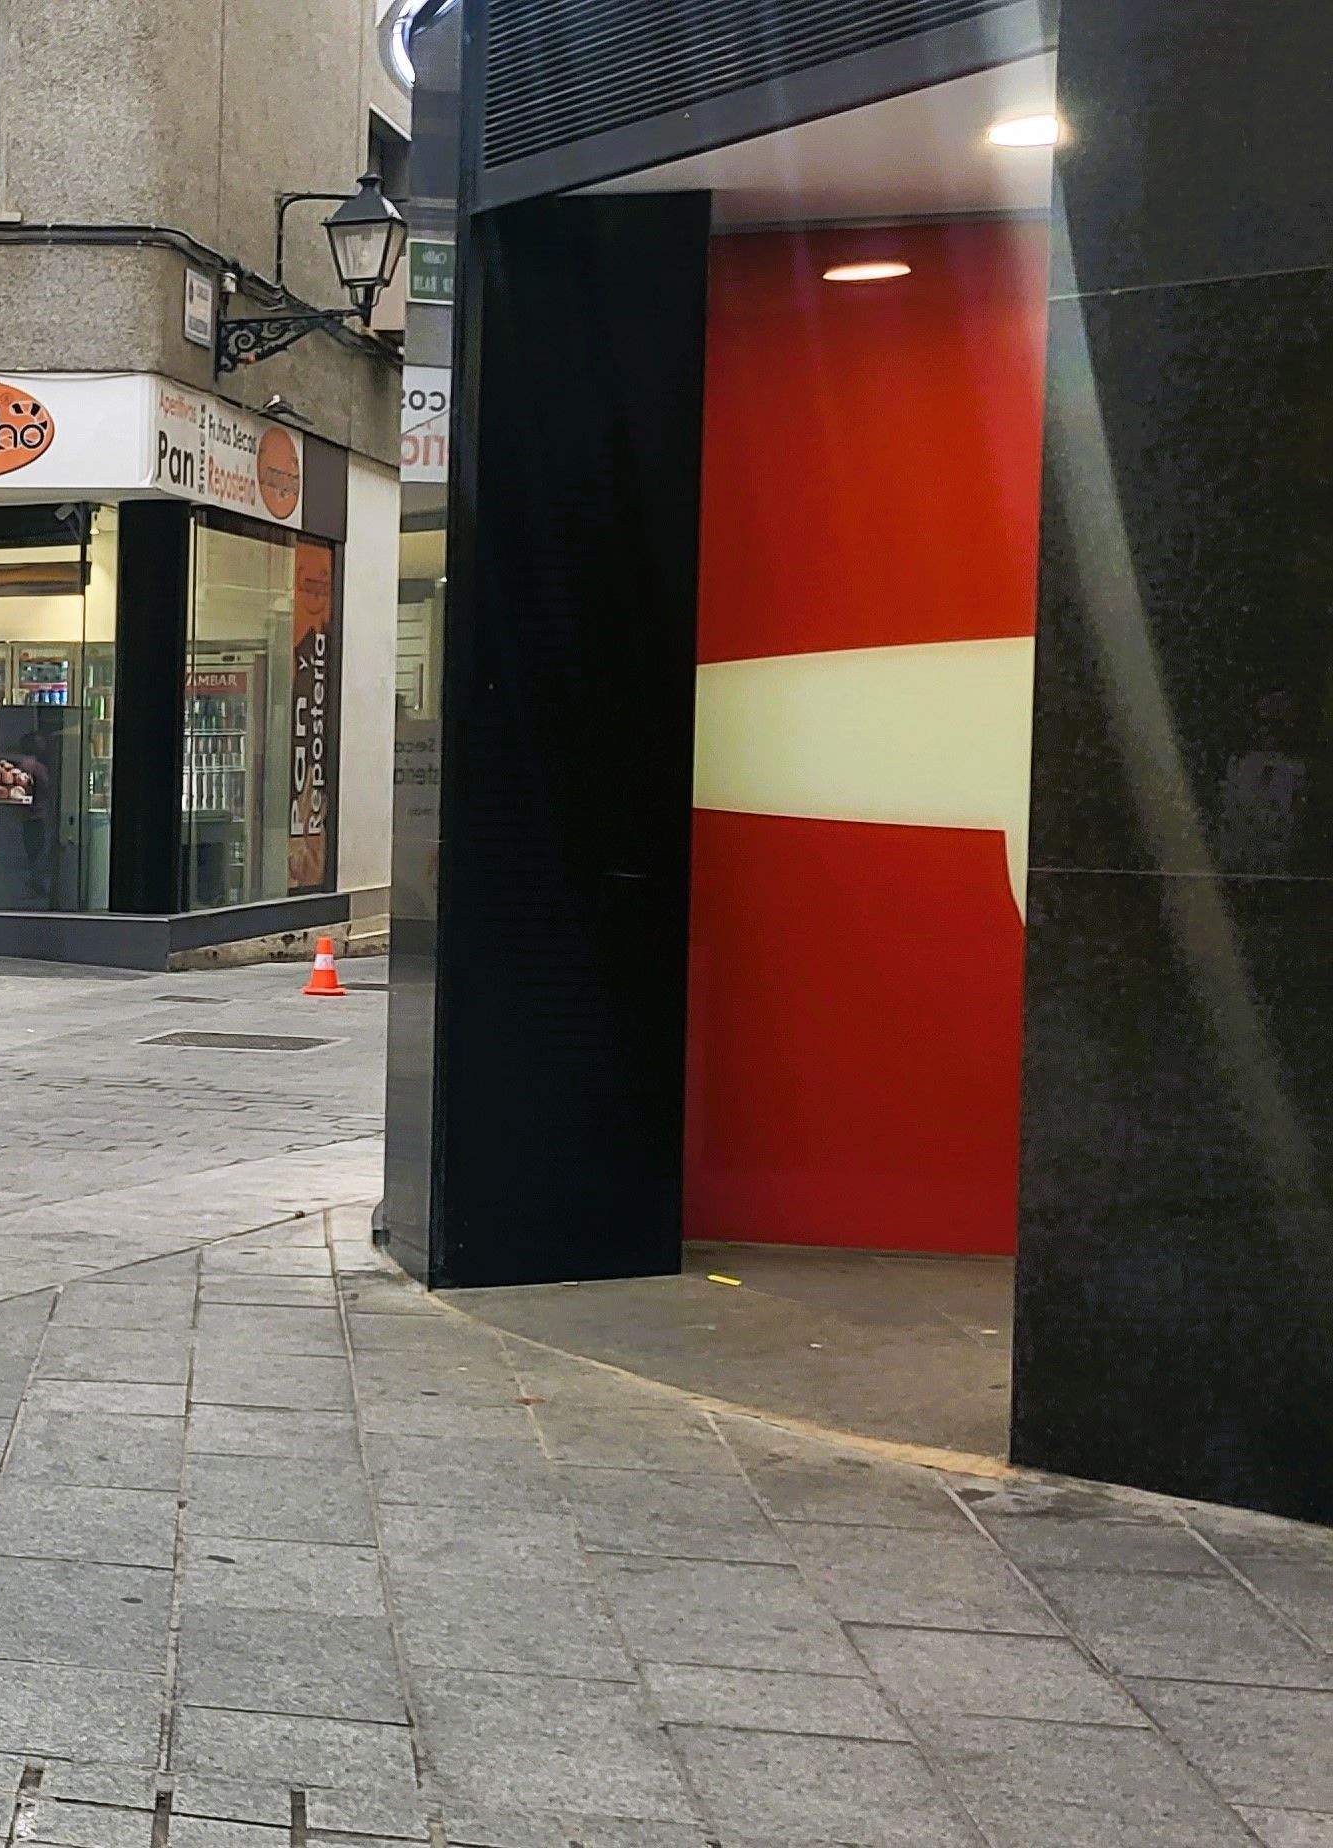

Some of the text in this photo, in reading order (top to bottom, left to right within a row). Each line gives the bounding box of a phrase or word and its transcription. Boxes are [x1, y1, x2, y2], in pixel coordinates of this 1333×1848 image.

[156, 430, 195, 488] Pan
[290, 655, 308, 836] Pan y
[308, 633, 326, 836] Repostería
